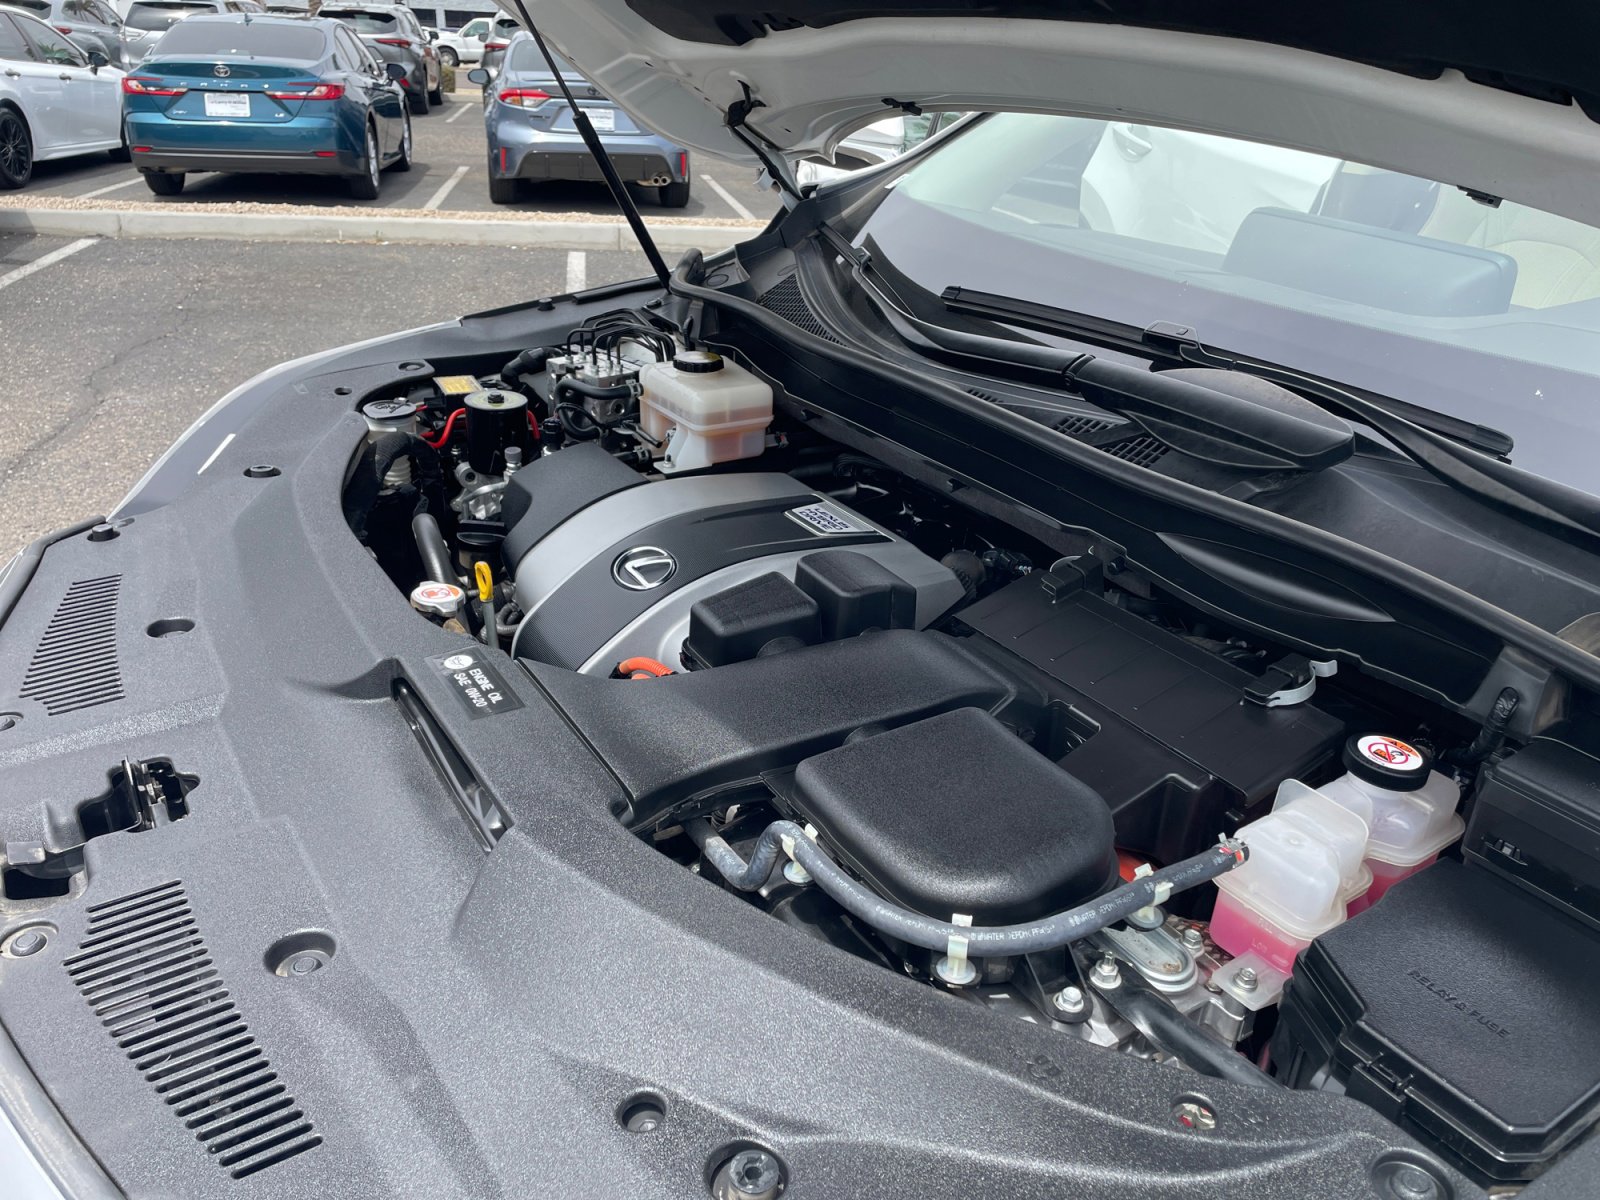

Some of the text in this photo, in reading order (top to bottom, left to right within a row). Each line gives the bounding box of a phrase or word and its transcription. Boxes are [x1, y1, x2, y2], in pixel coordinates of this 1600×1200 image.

[814, 508, 850, 529] LEXUS
[453, 672, 488, 707] SAE 0W-20
[468, 668, 504, 704] ENGINE OIL
[984, 932, 1004, 940] WATER
[1407, 970, 1457, 1002] RELAY
[1468, 1009, 1511, 1039] FUSE
